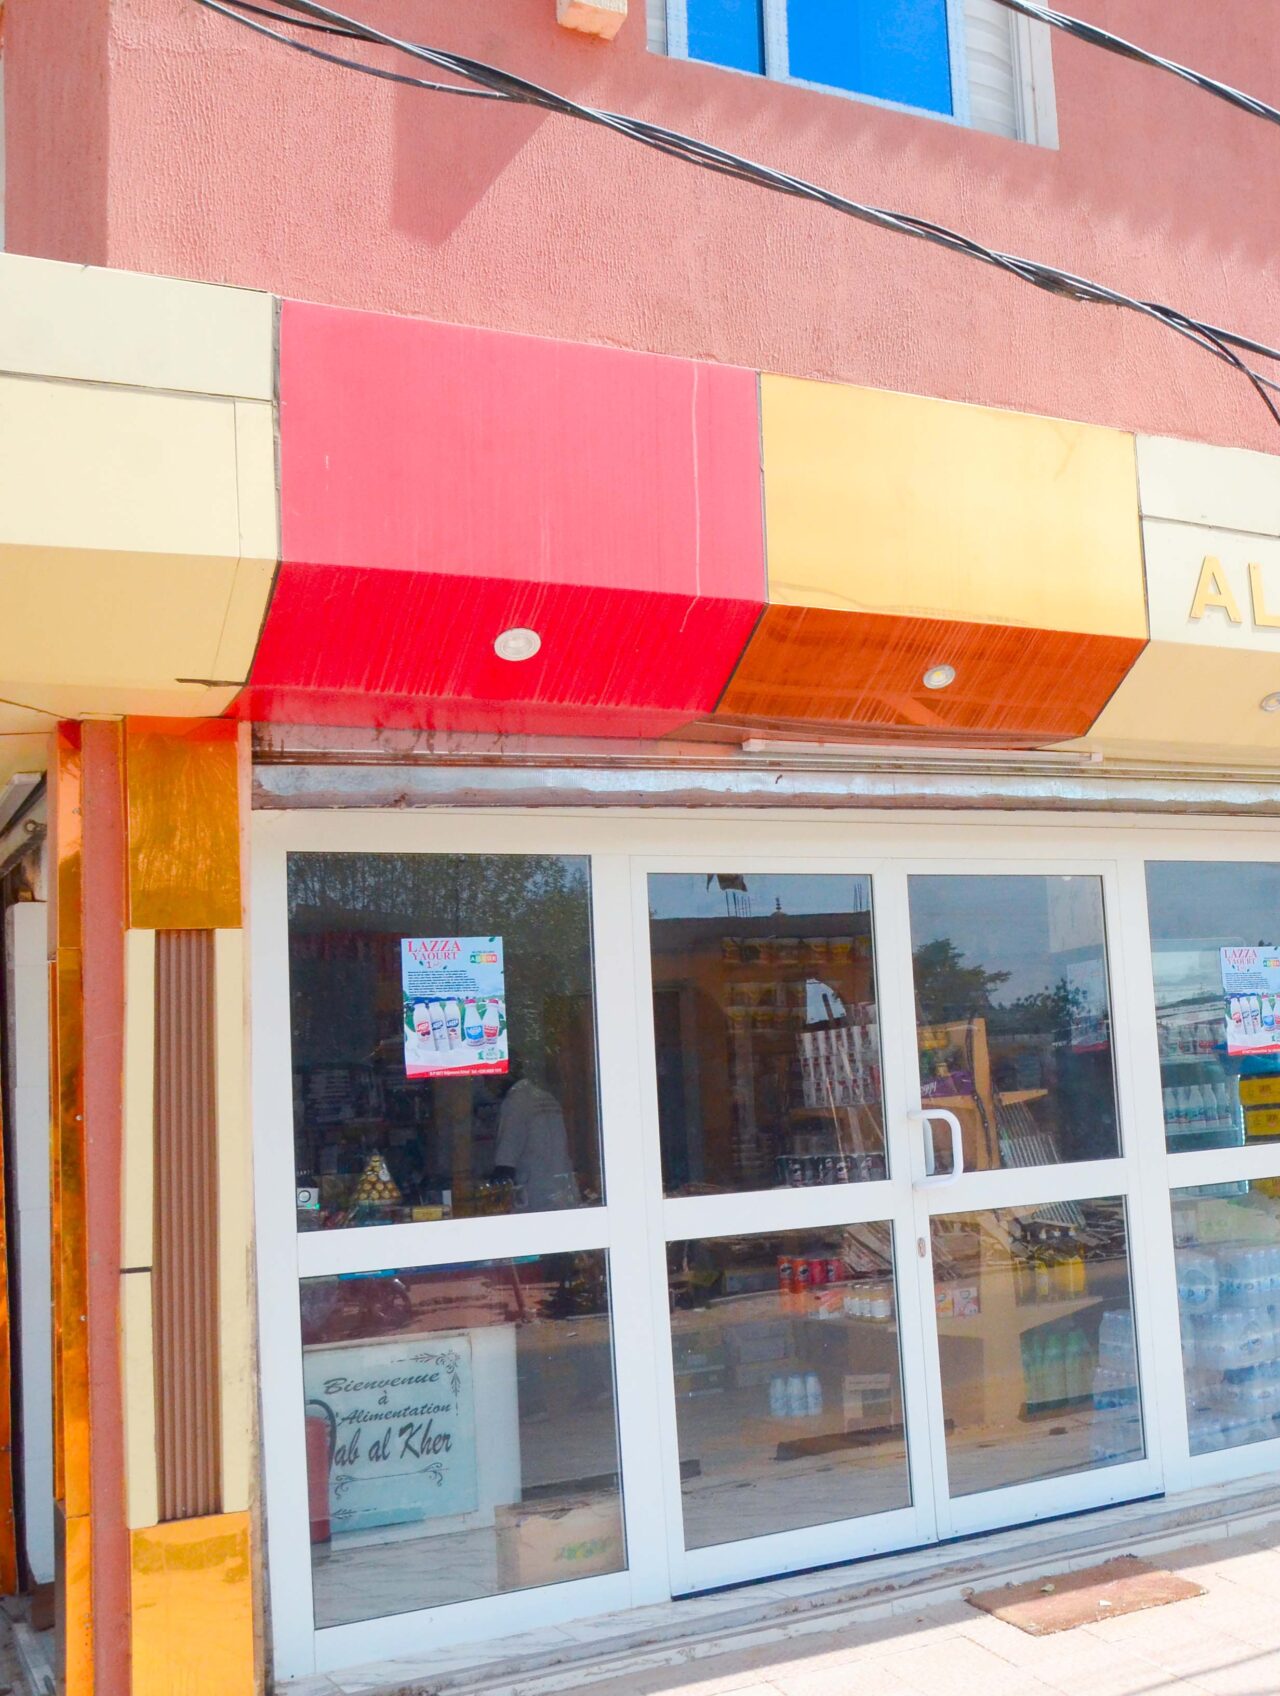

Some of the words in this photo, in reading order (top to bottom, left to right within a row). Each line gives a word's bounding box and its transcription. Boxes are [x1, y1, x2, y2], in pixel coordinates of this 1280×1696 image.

[408, 940, 461, 952] LAZZA
[412, 951, 457, 961] YAOURT
[323, 1371, 441, 1395] Bienvenue
[325, 1402, 451, 1427] 'Alimentation
[368, 1426, 391, 1463] al
[398, 1418, 453, 1461] Kher
